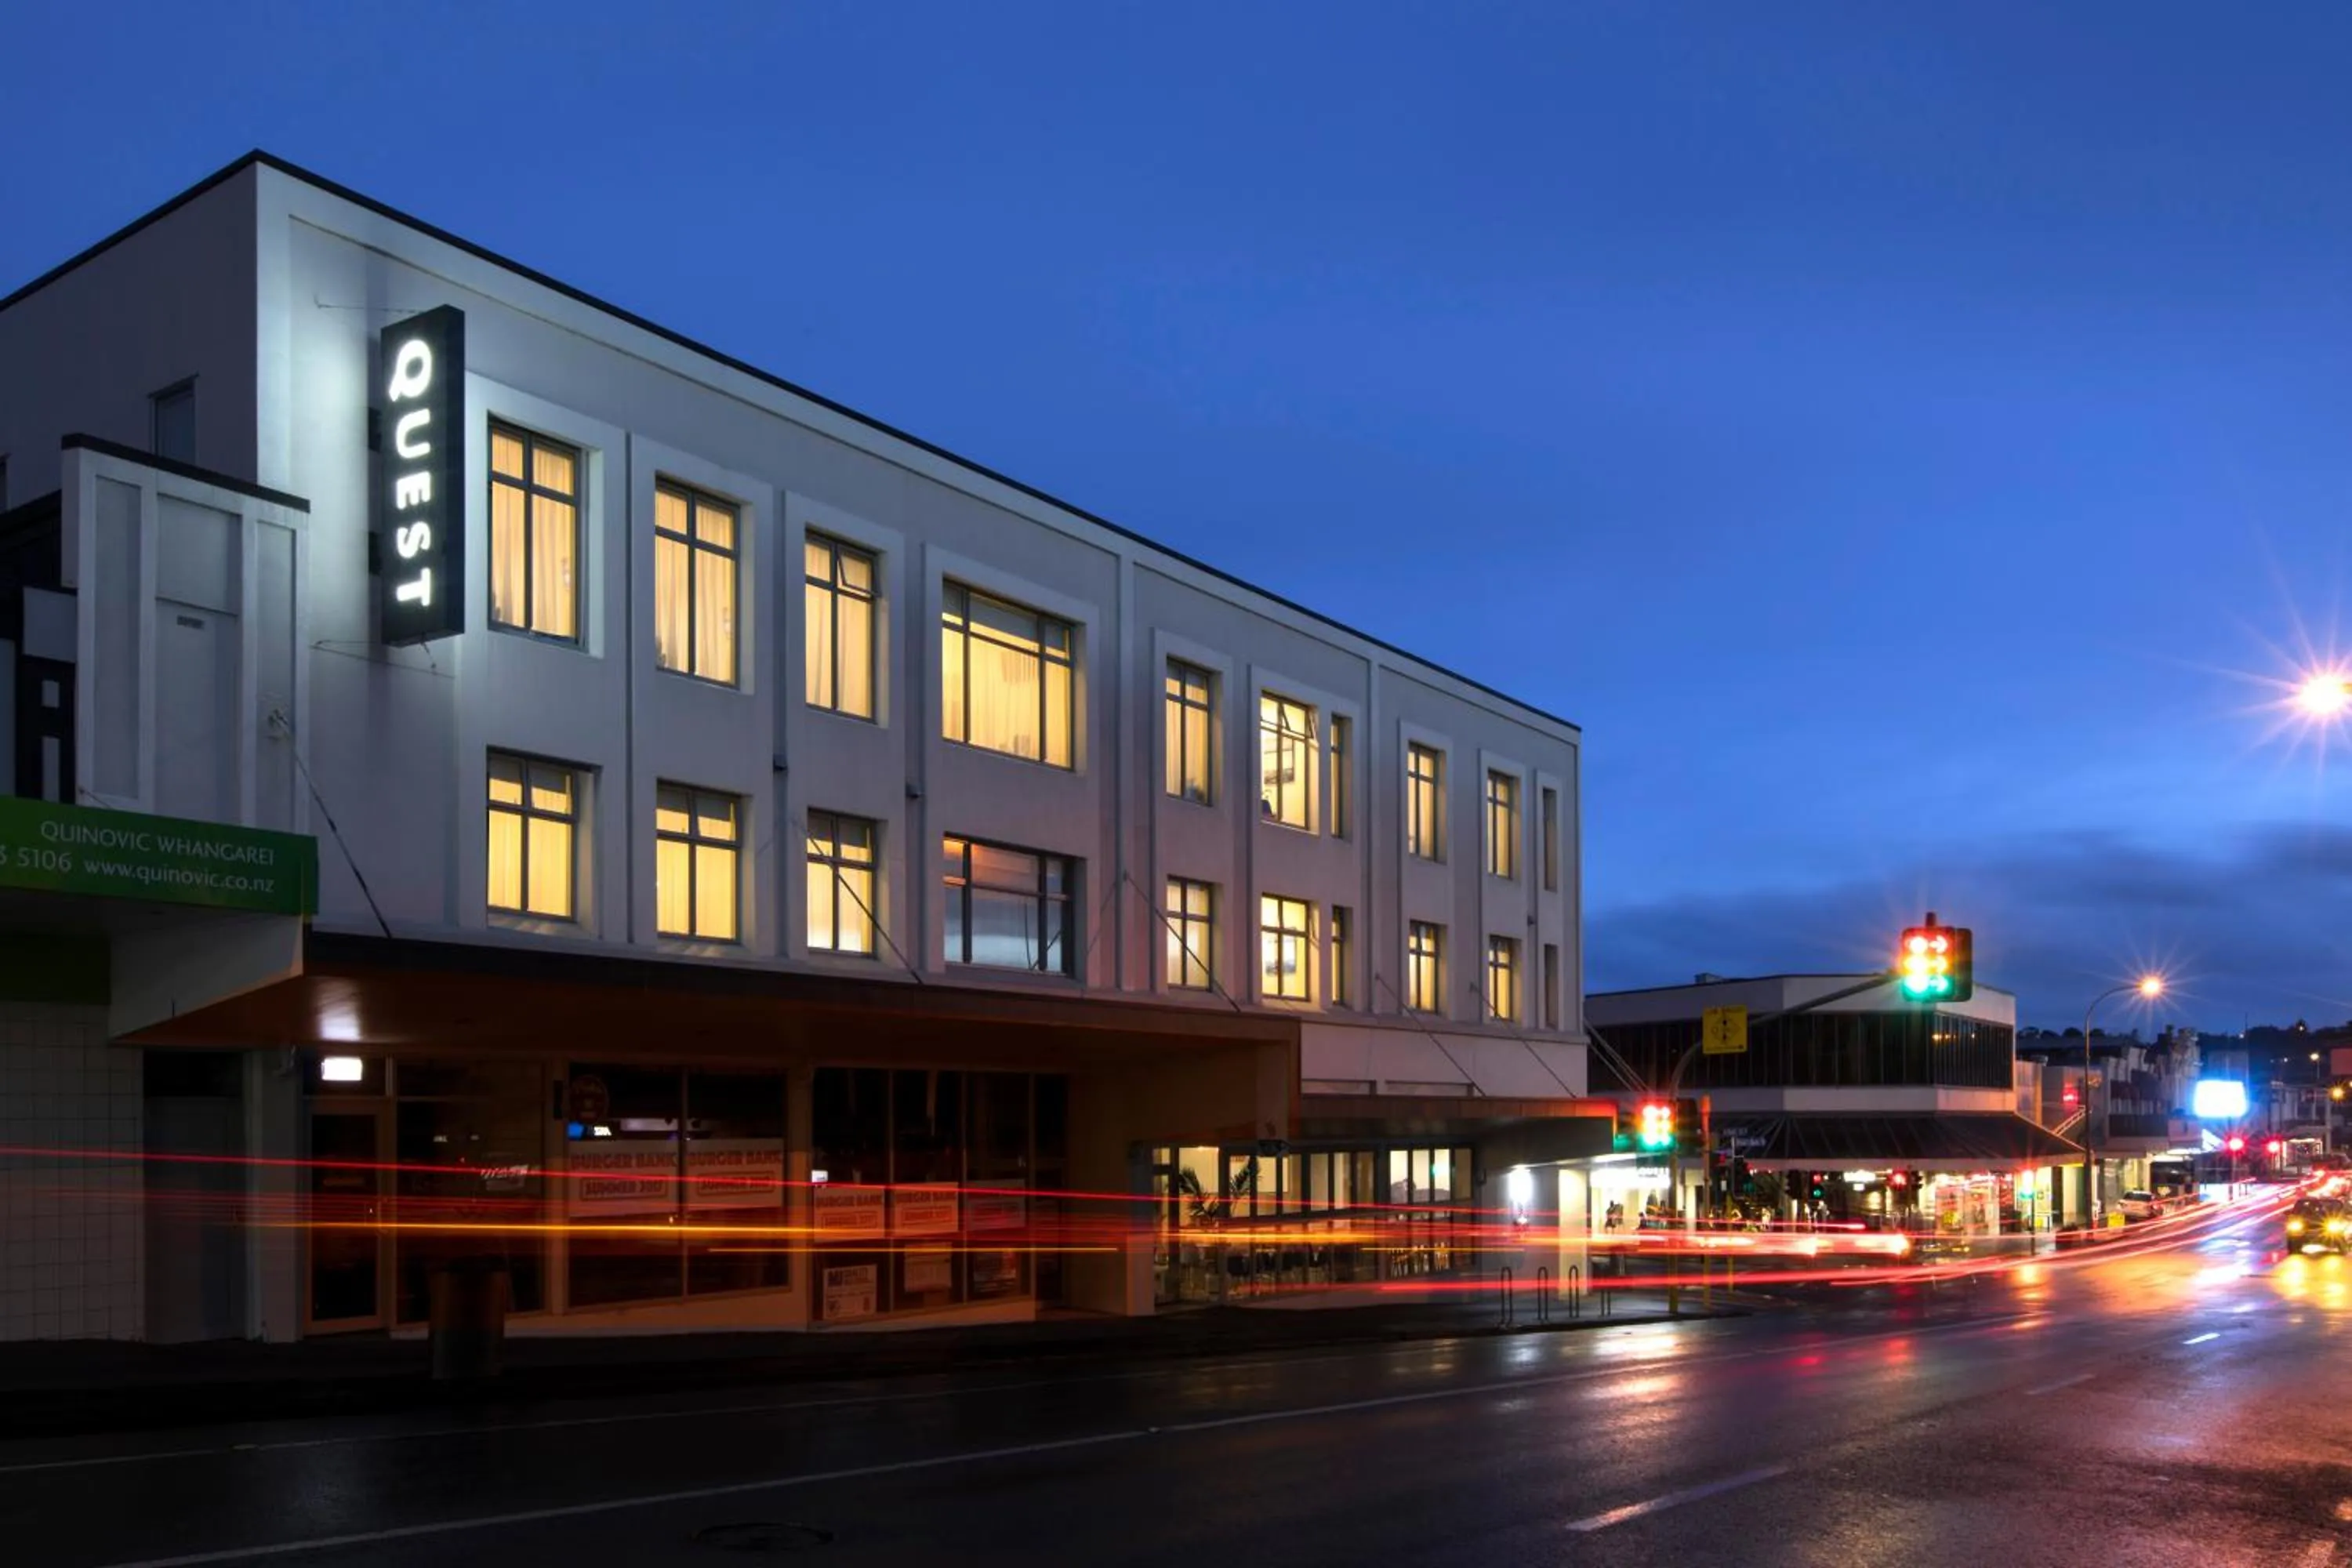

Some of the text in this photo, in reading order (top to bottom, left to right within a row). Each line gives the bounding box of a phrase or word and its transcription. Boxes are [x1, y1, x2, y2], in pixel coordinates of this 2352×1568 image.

[389, 339, 432, 607] QUEST
[40, 821, 274, 866] QUINOVIC WHANGAREI
[17, 847, 72, 872] 5106
[84, 859, 275, 893] www.quinovic.co.nz
